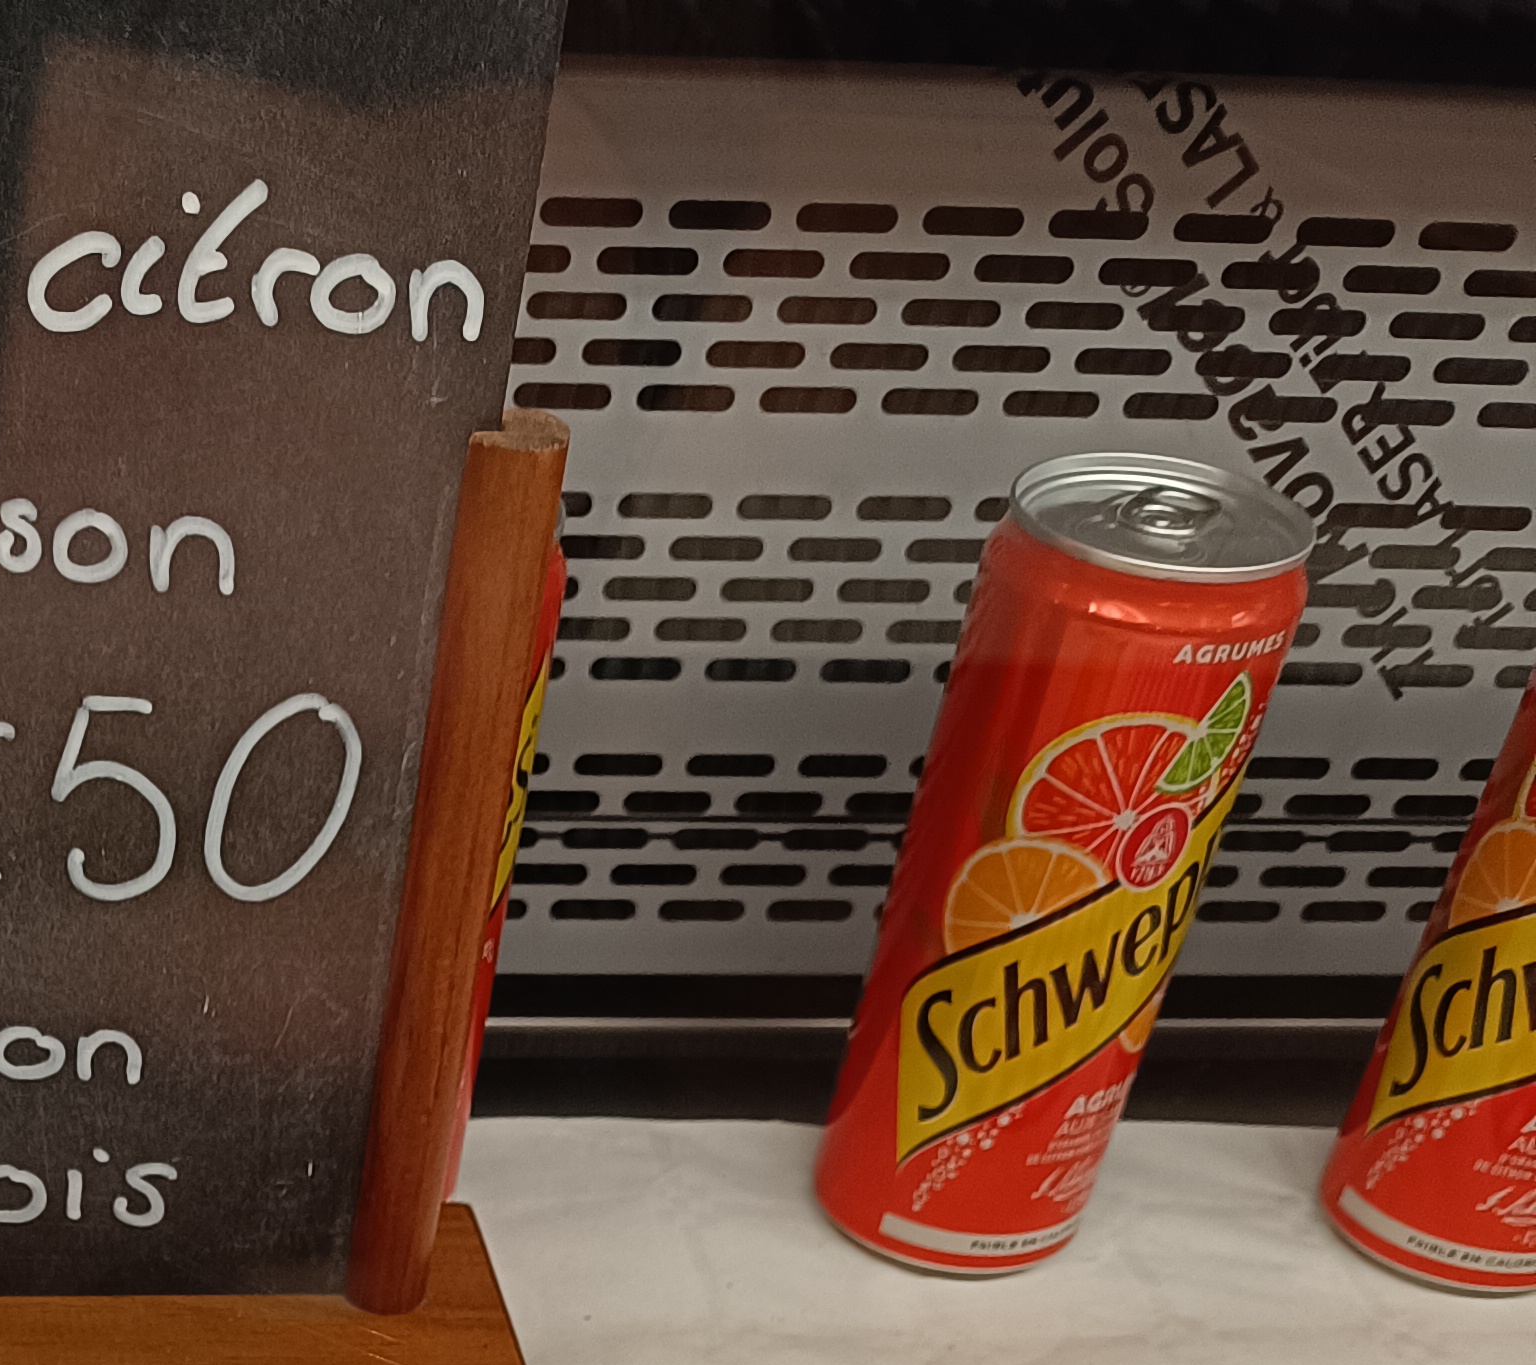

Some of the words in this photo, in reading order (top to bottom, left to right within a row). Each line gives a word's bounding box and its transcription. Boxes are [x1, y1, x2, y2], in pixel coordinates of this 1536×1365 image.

[1133, 77, 1260, 208] LAS
[27, 179, 485, 342] citron
[1172, 629, 1287, 665] AGRUMES
